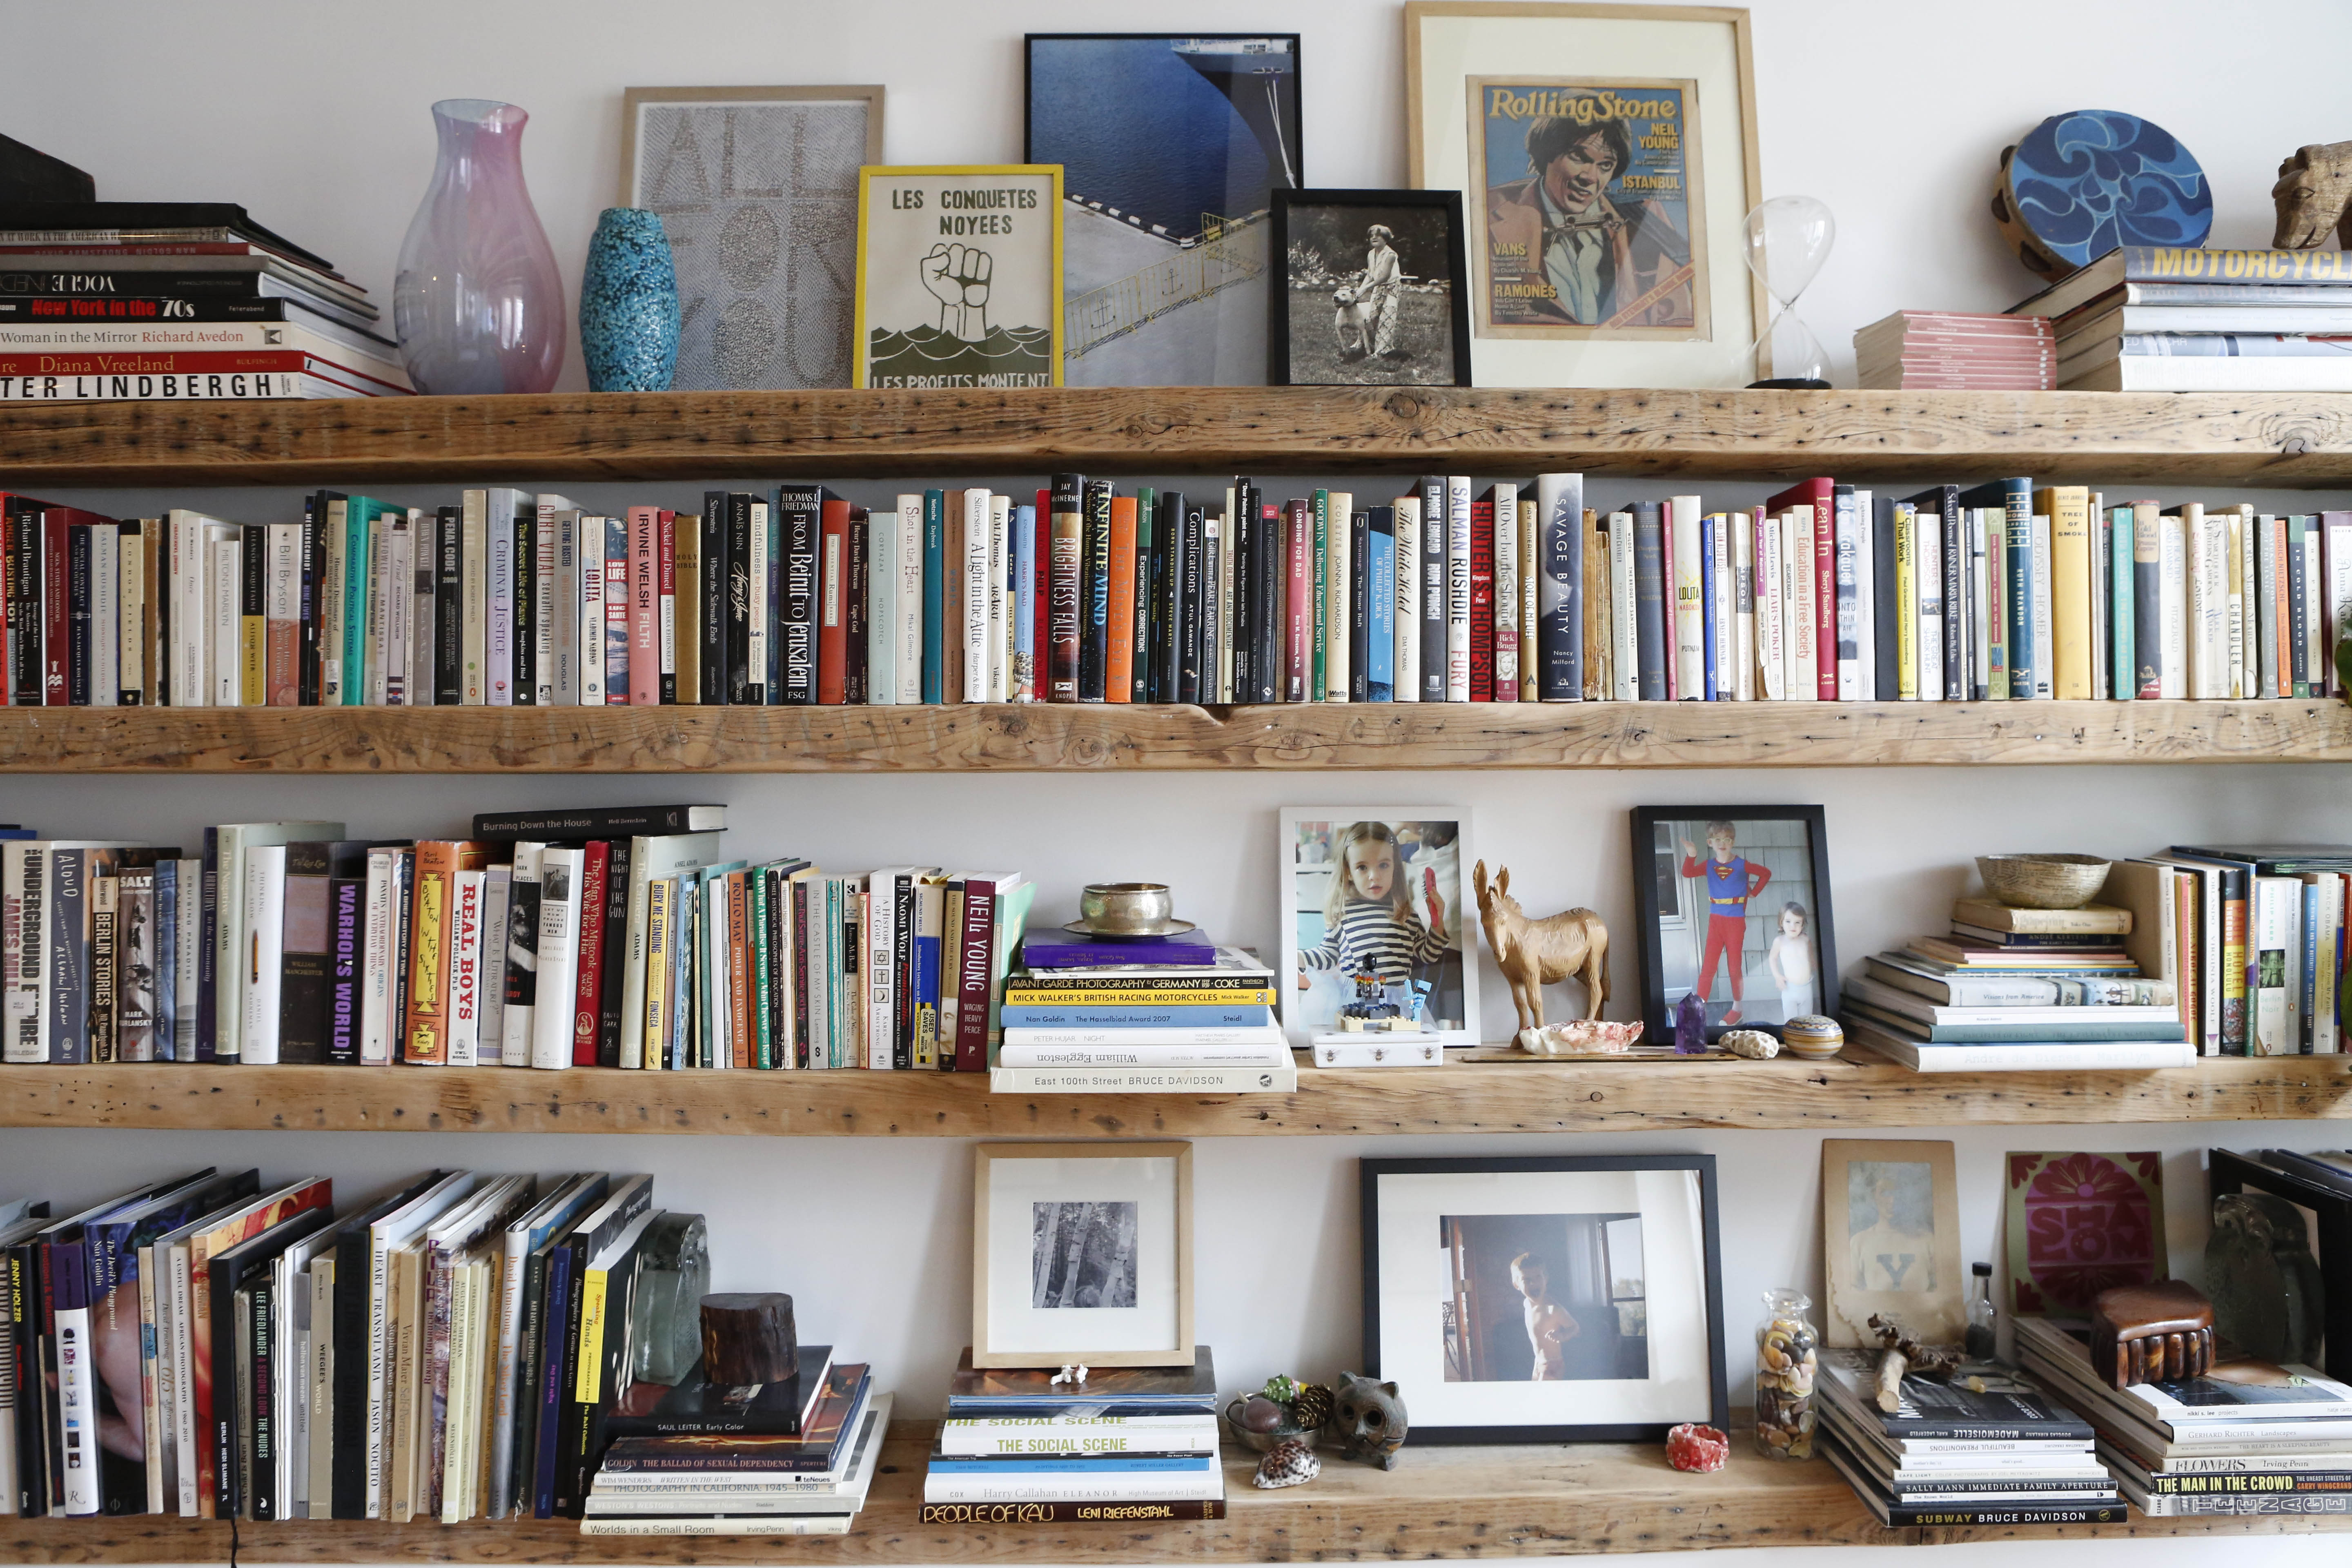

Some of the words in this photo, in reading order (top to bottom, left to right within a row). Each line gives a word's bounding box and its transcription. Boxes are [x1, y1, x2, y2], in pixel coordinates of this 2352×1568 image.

[1639, 136, 1679, 149] YOUNG
[1651, 123, 1677, 136] NEIL
[1622, 176, 1681, 189] ISTANBUL
[893, 189, 923, 209] LES
[941, 189, 1036, 209] CONQUETES
[940, 215, 1012, 235] NOYEES
[1494, 243, 1526, 255] VANS
[2152, 248, 2352, 279] MOTORCYCL
[1494, 285, 1557, 298] RAMONES
[32, 300, 68, 316] New
[71, 300, 105, 316] York
[109, 299, 126, 316] in
[129, 299, 156, 316] the
[162, 300, 195, 317] 70s
[1, 332, 50, 343] Woman
[53, 332, 68, 343] in
[71, 331, 91, 343] the
[94, 331, 137, 343] Mirror
[142, 331, 194, 342] Richard
[197, 331, 243, 342] Avedon
[40, 356, 92, 372] Diana
[97, 355, 174, 371] Vreeland
[0, 376, 58, 398] TER
[77, 374, 271, 397] LINDBERGH
[1452, 488, 1468, 550] SALMAN
[1556, 498, 1568, 561] SAVAGE
[1817, 495, 1831, 535] Lean
[22, 515, 31, 550] Richard
[639, 514, 648, 557] IRVINE
[663, 521, 671, 545] Nickel
[793, 514, 806, 550] FROM
[1474, 506, 1490, 572] HUNTER
[279, 546, 290, 564] Bill
[663, 547, 671, 561] and
[972, 544, 984, 552] A
[1186, 512, 1200, 593] Complications
[1818, 540, 1833, 557] In
[21, 552, 31, 595] Brautigan
[496, 540, 509, 601] CRIMINAL
[663, 563, 671, 589] Dimed
[788, 553, 813, 599] Beirut
[968, 555, 986, 583] Light
[1053, 538, 1076, 606] BRIGHTNESS
[1138, 555, 1146, 607] Experiencing
[276, 570, 290, 615] Bryson
[586, 569, 600, 602] LOLITA
[639, 562, 649, 608] WELSH
[753, 586, 762, 604] busy
[972, 586, 984, 598] in
[1452, 558, 1467, 624] RUSHDIE
[1473, 581, 1490, 597] S.
[1679, 587, 1700, 600] LOLITA
[792, 600, 805, 618] TO
[972, 600, 985, 618] the
[1557, 573, 1568, 634] BEAUTY
[1822, 594, 1830, 628] Sandberg
[494, 606, 507, 655] JUSTICE
[639, 612, 650, 648] FILTH
[971, 619, 985, 647] Attic
[1053, 612, 1074, 643] FALLS
[1138, 610, 1146, 653] CORRECTIONS
[2230, 604, 2241, 665] CHANDLER
[781, 620, 813, 688] Jerusalem
[1472, 603, 1490, 694] THOMPSON
[1451, 650, 1466, 689] FURY
[483, 823, 518, 831] Burning
[655, 885, 664, 903] BURY
[461, 884, 476, 951] REAL
[653, 905, 663, 916] ME
[969, 895, 990, 932] NEIL
[96, 914, 111, 954] BERLIN
[336, 885, 355, 976] WARHOL'S
[652, 919, 662, 953] STANDING
[964, 940, 987, 991] YOUNG
[2233, 951, 2243, 992] HOTEL
[96, 958, 111, 1006] STORIES
[459, 958, 474, 1019] BOYS
[1013, 993, 1035, 1001] MICK
[1038, 993, 1082, 1001] WALKER'S
[334, 983, 352, 1047] WORLD
[649, 1001, 659, 1027] FONSECA
[736, 998, 744, 1044] INNOCENCE
[1037, 1053, 1092, 1062] Eggleston
[1096, 1053, 1137, 1062] William
[1061, 1077, 1088, 1085] 100th
[1168, 1076, 1223, 1085] DAVIDSON
[374, 1251, 383, 1287] HEART
[256, 1292, 265, 1303] LEE
[594, 1294, 602, 1325] Speaking
[257, 1306, 267, 1355] FRIEDLANDER
[372, 1298, 383, 1381] TRANSYLVANIA
[584, 1318, 593, 1348] Hands
[371, 1399, 381, 1433] JASON
[997, 1439, 1023, 1452] THE
[1028, 1439, 1078, 1452] SOCIAL
[1082, 1438, 1127, 1450] SCENE
[1954, 1430, 2019, 1439] MADEMOISELLE
[370, 1443, 380, 1487] NOCITO
[2175, 1458, 2246, 1471] FLOWERS
[2156, 1478, 2178, 1492] THE
[2180, 1477, 2206, 1491] MAN
[2209, 1477, 2220, 1490] IN
[2225, 1476, 2247, 1490] THE
[2251, 1475, 2293, 1490] CROWD
[923, 1505, 989, 1523] PEOPLE
[991, 1505, 1015, 1521] OF
[1018, 1503, 1054, 1521] KAU
[1078, 1507, 1101, 1518] LENI
[1103, 1505, 1174, 1519] RIEFENSTAHL
[1916, 1515, 1972, 1524] SUBWAY
[1978, 1513, 2018, 1523] BRUCE
[2025, 1512, 2086, 1522] DAVIDSON
